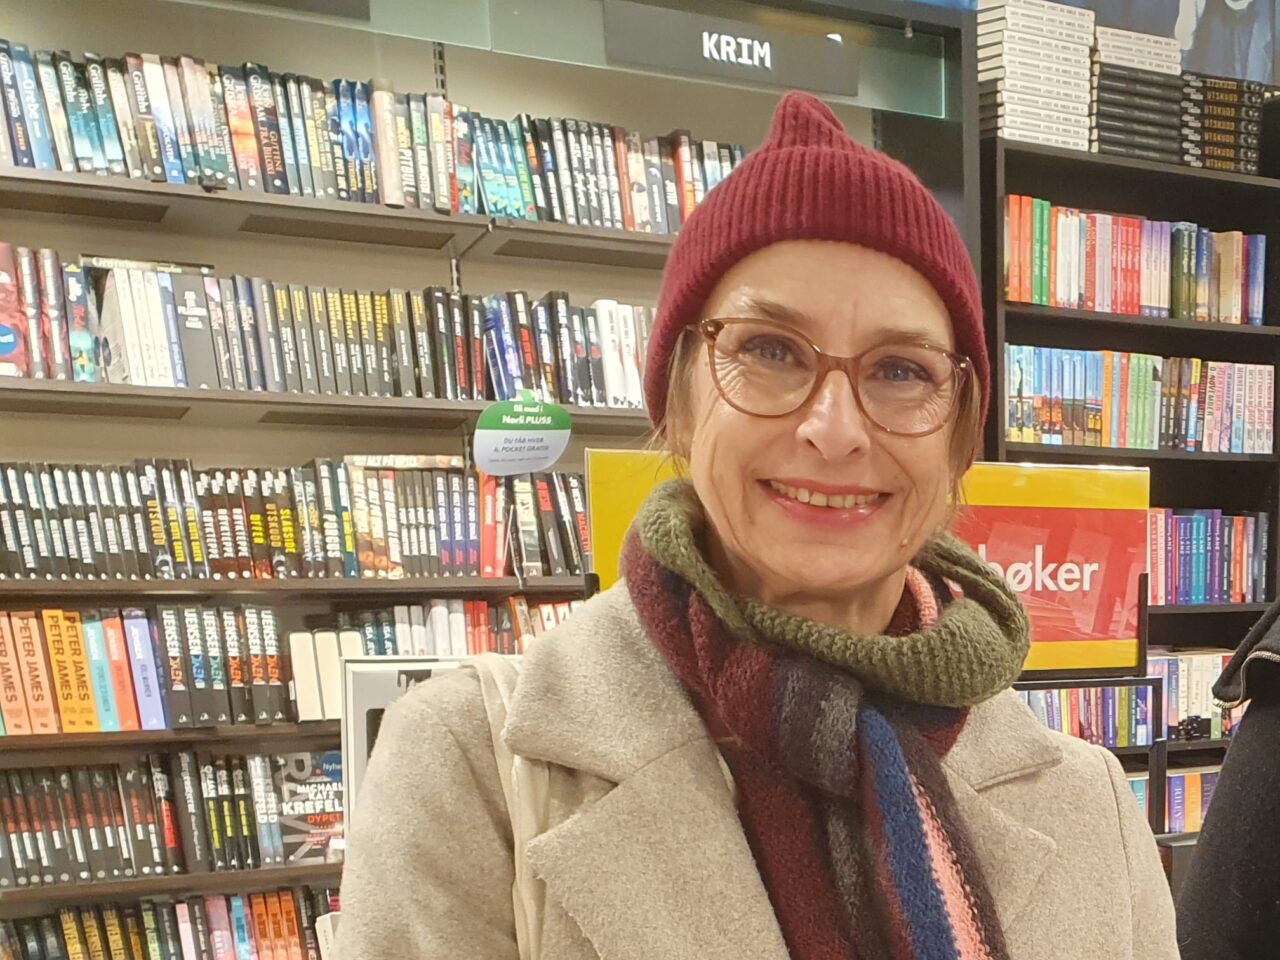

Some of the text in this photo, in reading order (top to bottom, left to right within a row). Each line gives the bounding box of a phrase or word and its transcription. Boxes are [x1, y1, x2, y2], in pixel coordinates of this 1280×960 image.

[702, 31, 772, 70] KRIM
[399, 149, 416, 192] PITBULL
[502, 415, 552, 424] Norli PLUSS
[250, 514, 265, 544] OFFER
[280, 508, 296, 553] SLAGSIDE
[18, 616, 44, 702] PETER JAMES
[48, 615, 73, 701] PETER JAMES
[64, 615, 90, 701] PETER JAMES
[2, 660, 17, 703] JAMES
[282, 798, 344, 815] KREFEL
[297, 783, 343, 793] MICHAEL
[307, 814, 341, 823] DYPET
